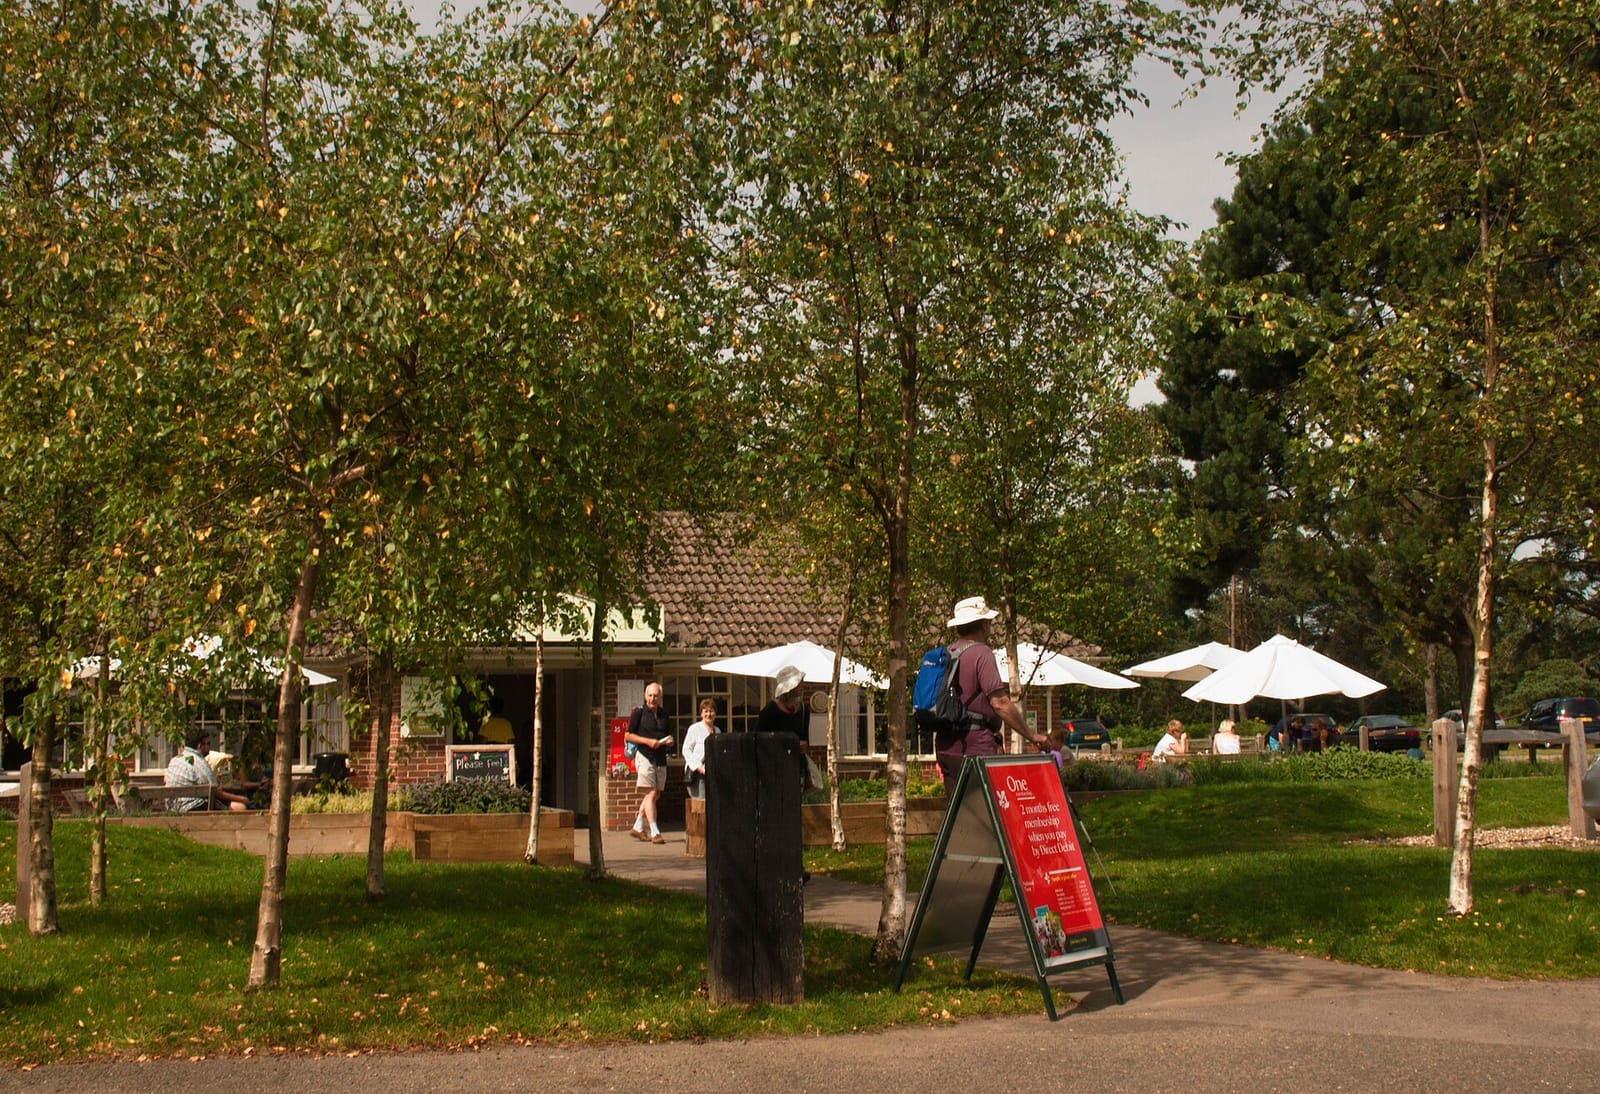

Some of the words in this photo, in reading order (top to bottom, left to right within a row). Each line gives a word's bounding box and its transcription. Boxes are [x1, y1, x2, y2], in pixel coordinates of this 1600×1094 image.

[456, 758, 484, 770] Please
[1006, 775, 1029, 792] One
[1019, 804, 1026, 816] 2
[1025, 802, 1048, 815] months
[1046, 801, 1060, 813] free
[1024, 815, 1060, 829] membership
[1028, 831, 1045, 842] when
[1044, 831, 1056, 844] you
[1055, 830, 1067, 843] pay
[1031, 845, 1040, 859] by
[1039, 844, 1059, 855] Direct
[1056, 841, 1075, 853] Debit
